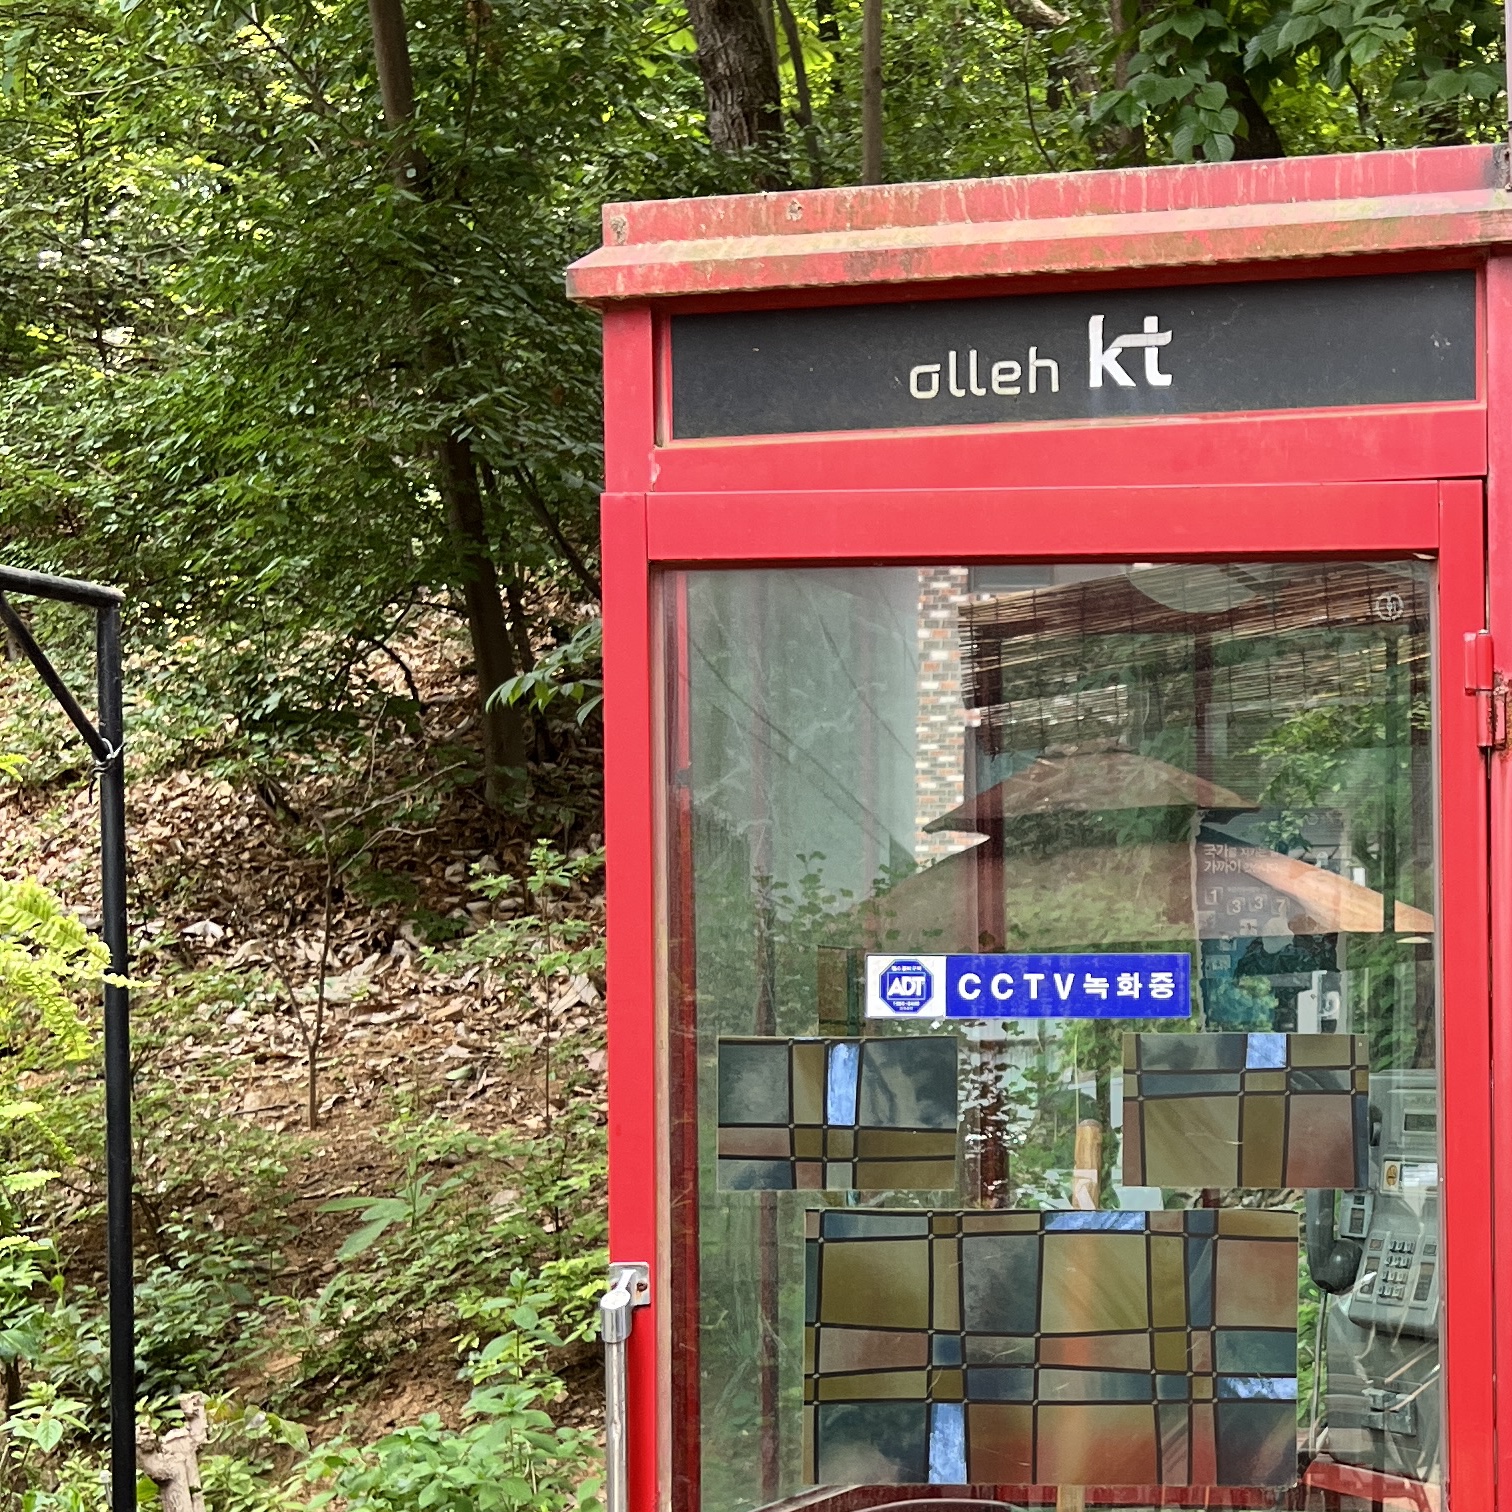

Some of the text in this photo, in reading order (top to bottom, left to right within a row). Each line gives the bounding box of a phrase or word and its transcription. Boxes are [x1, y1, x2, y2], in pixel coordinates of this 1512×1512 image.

[909, 314, 1173, 399] olleh kt
[887, 976, 926, 996] ADT
[958, 971, 1176, 1001] CCTV 녹화중
